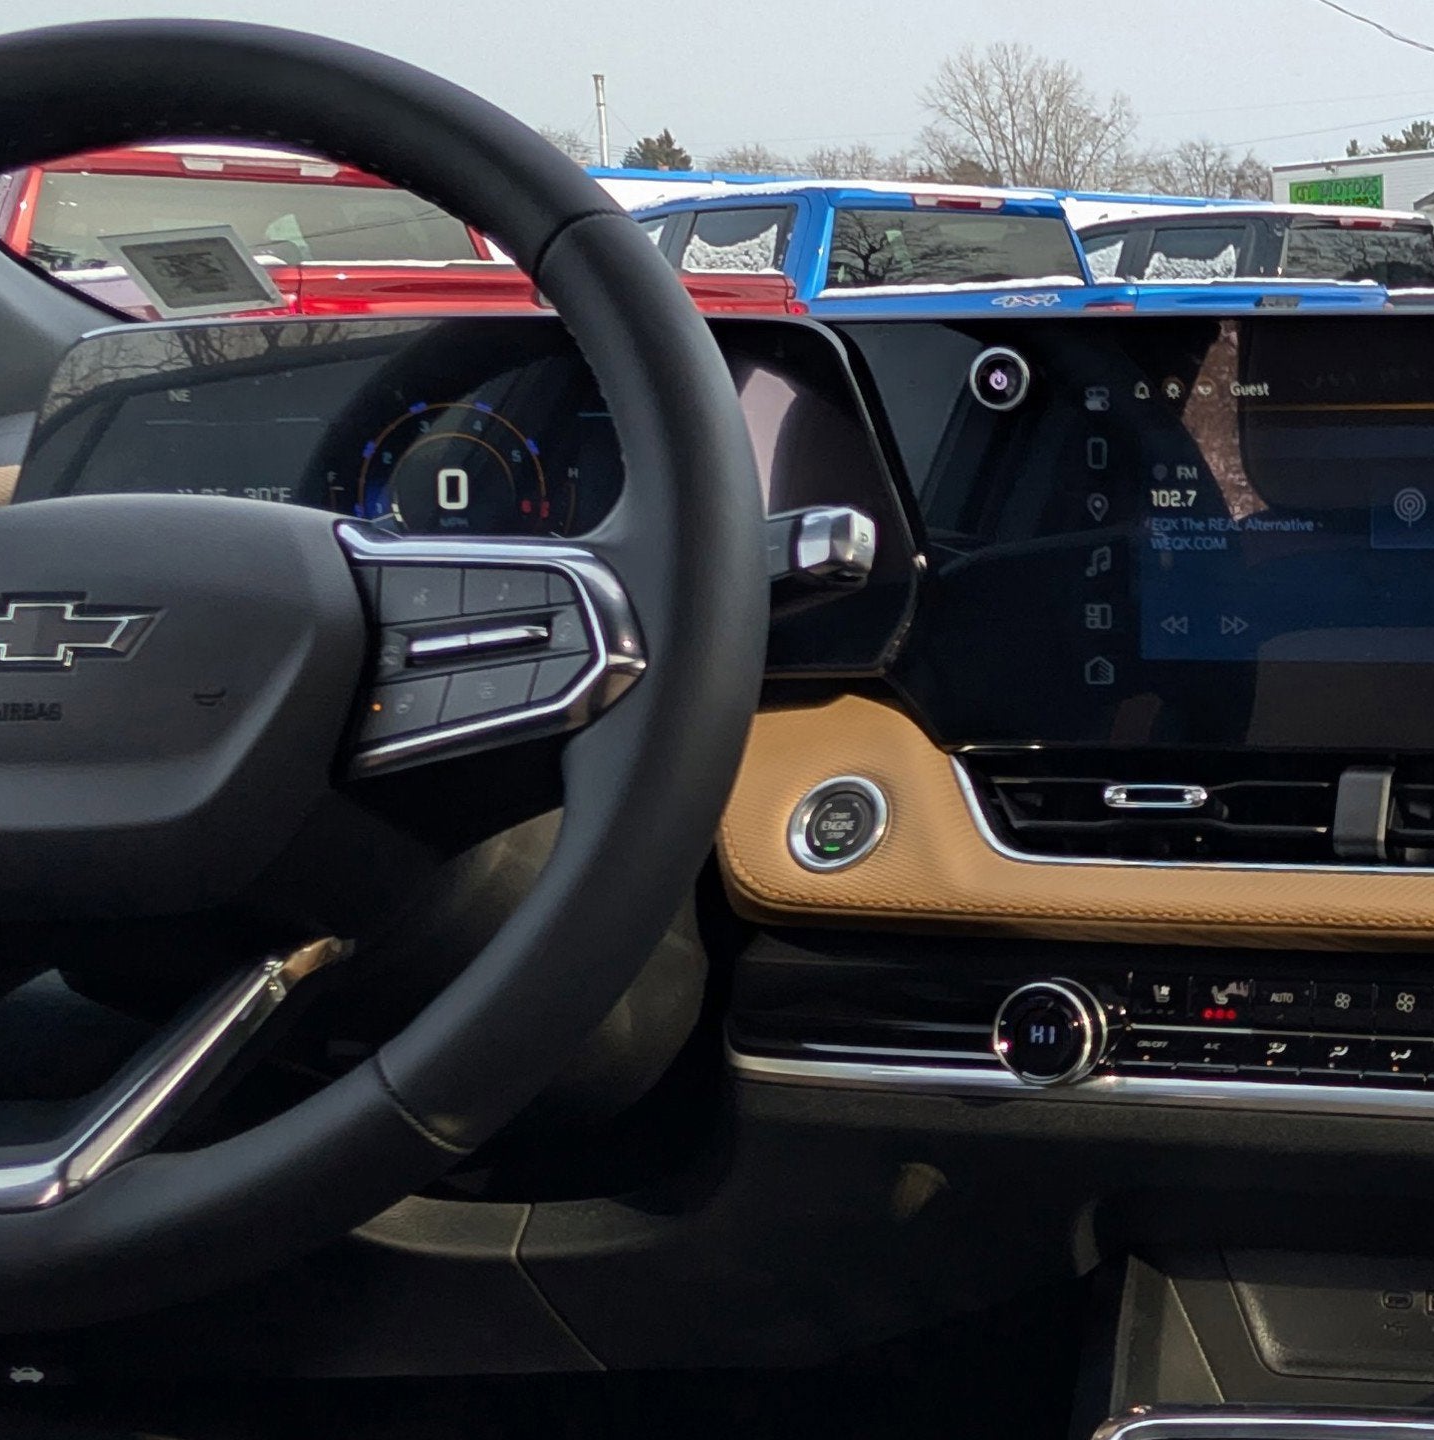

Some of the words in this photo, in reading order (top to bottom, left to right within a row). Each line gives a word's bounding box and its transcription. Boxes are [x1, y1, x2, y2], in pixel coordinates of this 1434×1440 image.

[168, 389, 191, 402] NE
[1230, 381, 1269, 396] Guest
[1176, 465, 1198, 480] FM
[437, 468, 469, 510] 0
[1150, 489, 1197, 507] 102.7
[1182, 518, 1206, 530] The
[1208, 518, 1242, 531] REAL
[1245, 517, 1315, 531] Alternative
[1149, 537, 1227, 550] WEQX.COM
[1270, 992, 1294, 1003] AUTO
[1030, 1024, 1056, 1044] HI
